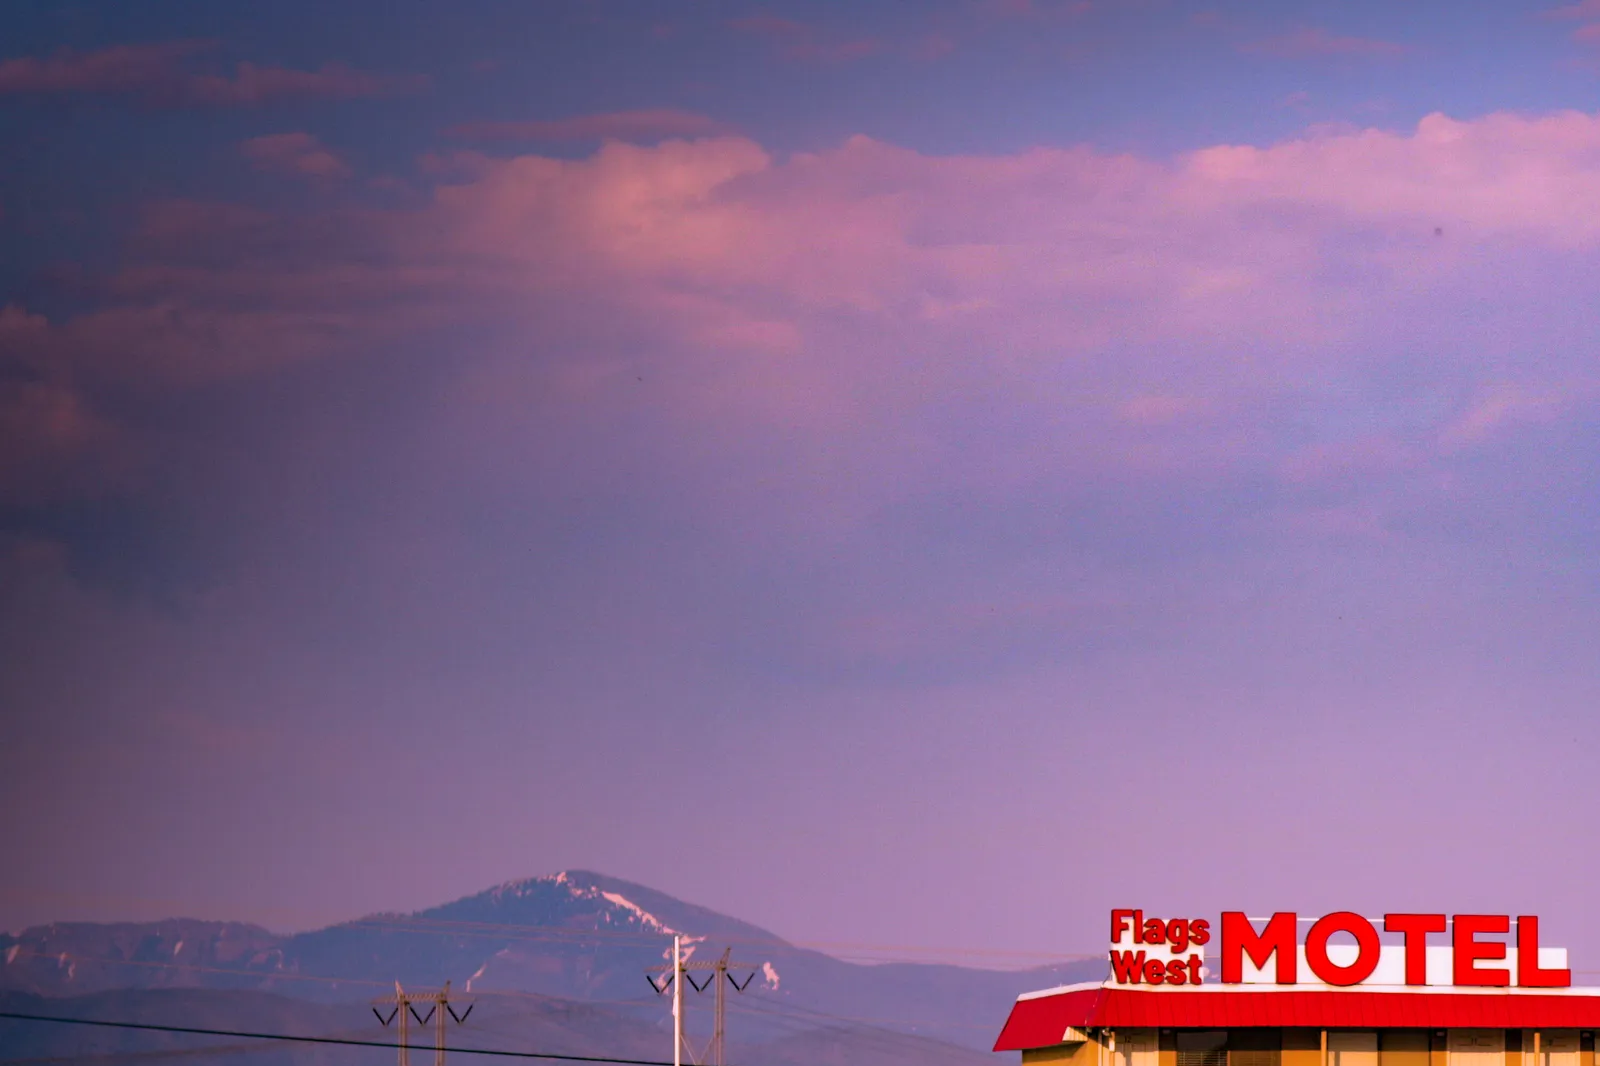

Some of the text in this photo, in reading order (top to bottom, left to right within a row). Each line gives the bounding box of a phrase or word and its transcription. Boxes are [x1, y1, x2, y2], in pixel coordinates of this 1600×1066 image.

[1111, 909, 1210, 954] Flags
[1221, 911, 1571, 987] MOTEL
[1110, 950, 1203, 986] West
